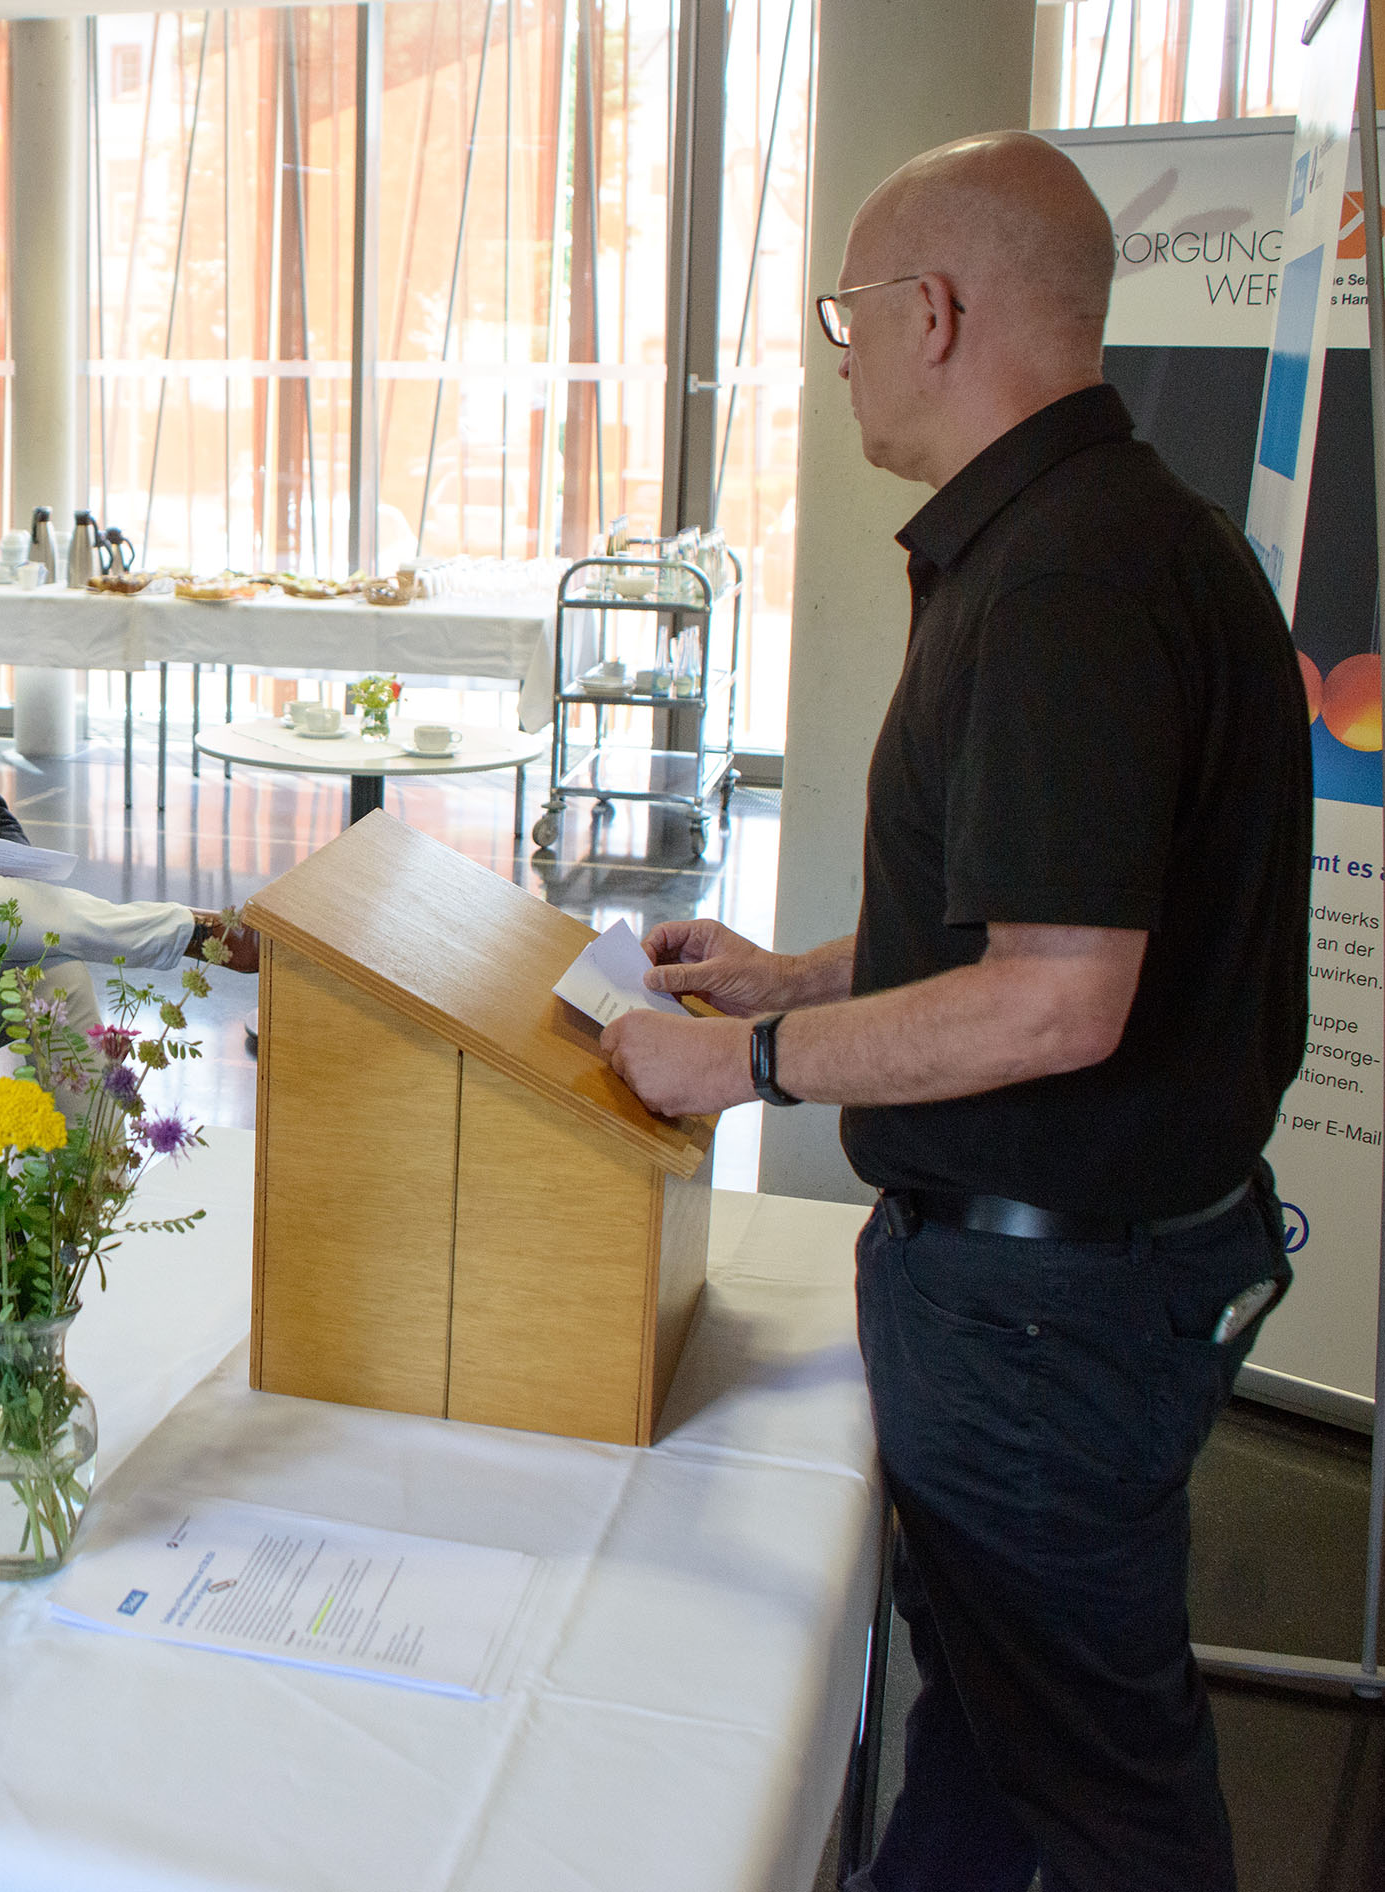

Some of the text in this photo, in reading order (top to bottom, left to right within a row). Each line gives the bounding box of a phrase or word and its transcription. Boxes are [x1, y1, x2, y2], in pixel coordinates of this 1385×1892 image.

[1347, 861, 1373, 878] es
[1317, 938, 1339, 952] an
[1344, 940, 1374, 957] der
[1308, 965, 1383, 990] uwirken.
[1304, 1042, 1381, 1067] orsorge-
[1292, 1115, 1321, 1131] per
[1326, 1120, 1382, 1146] E-Mail
